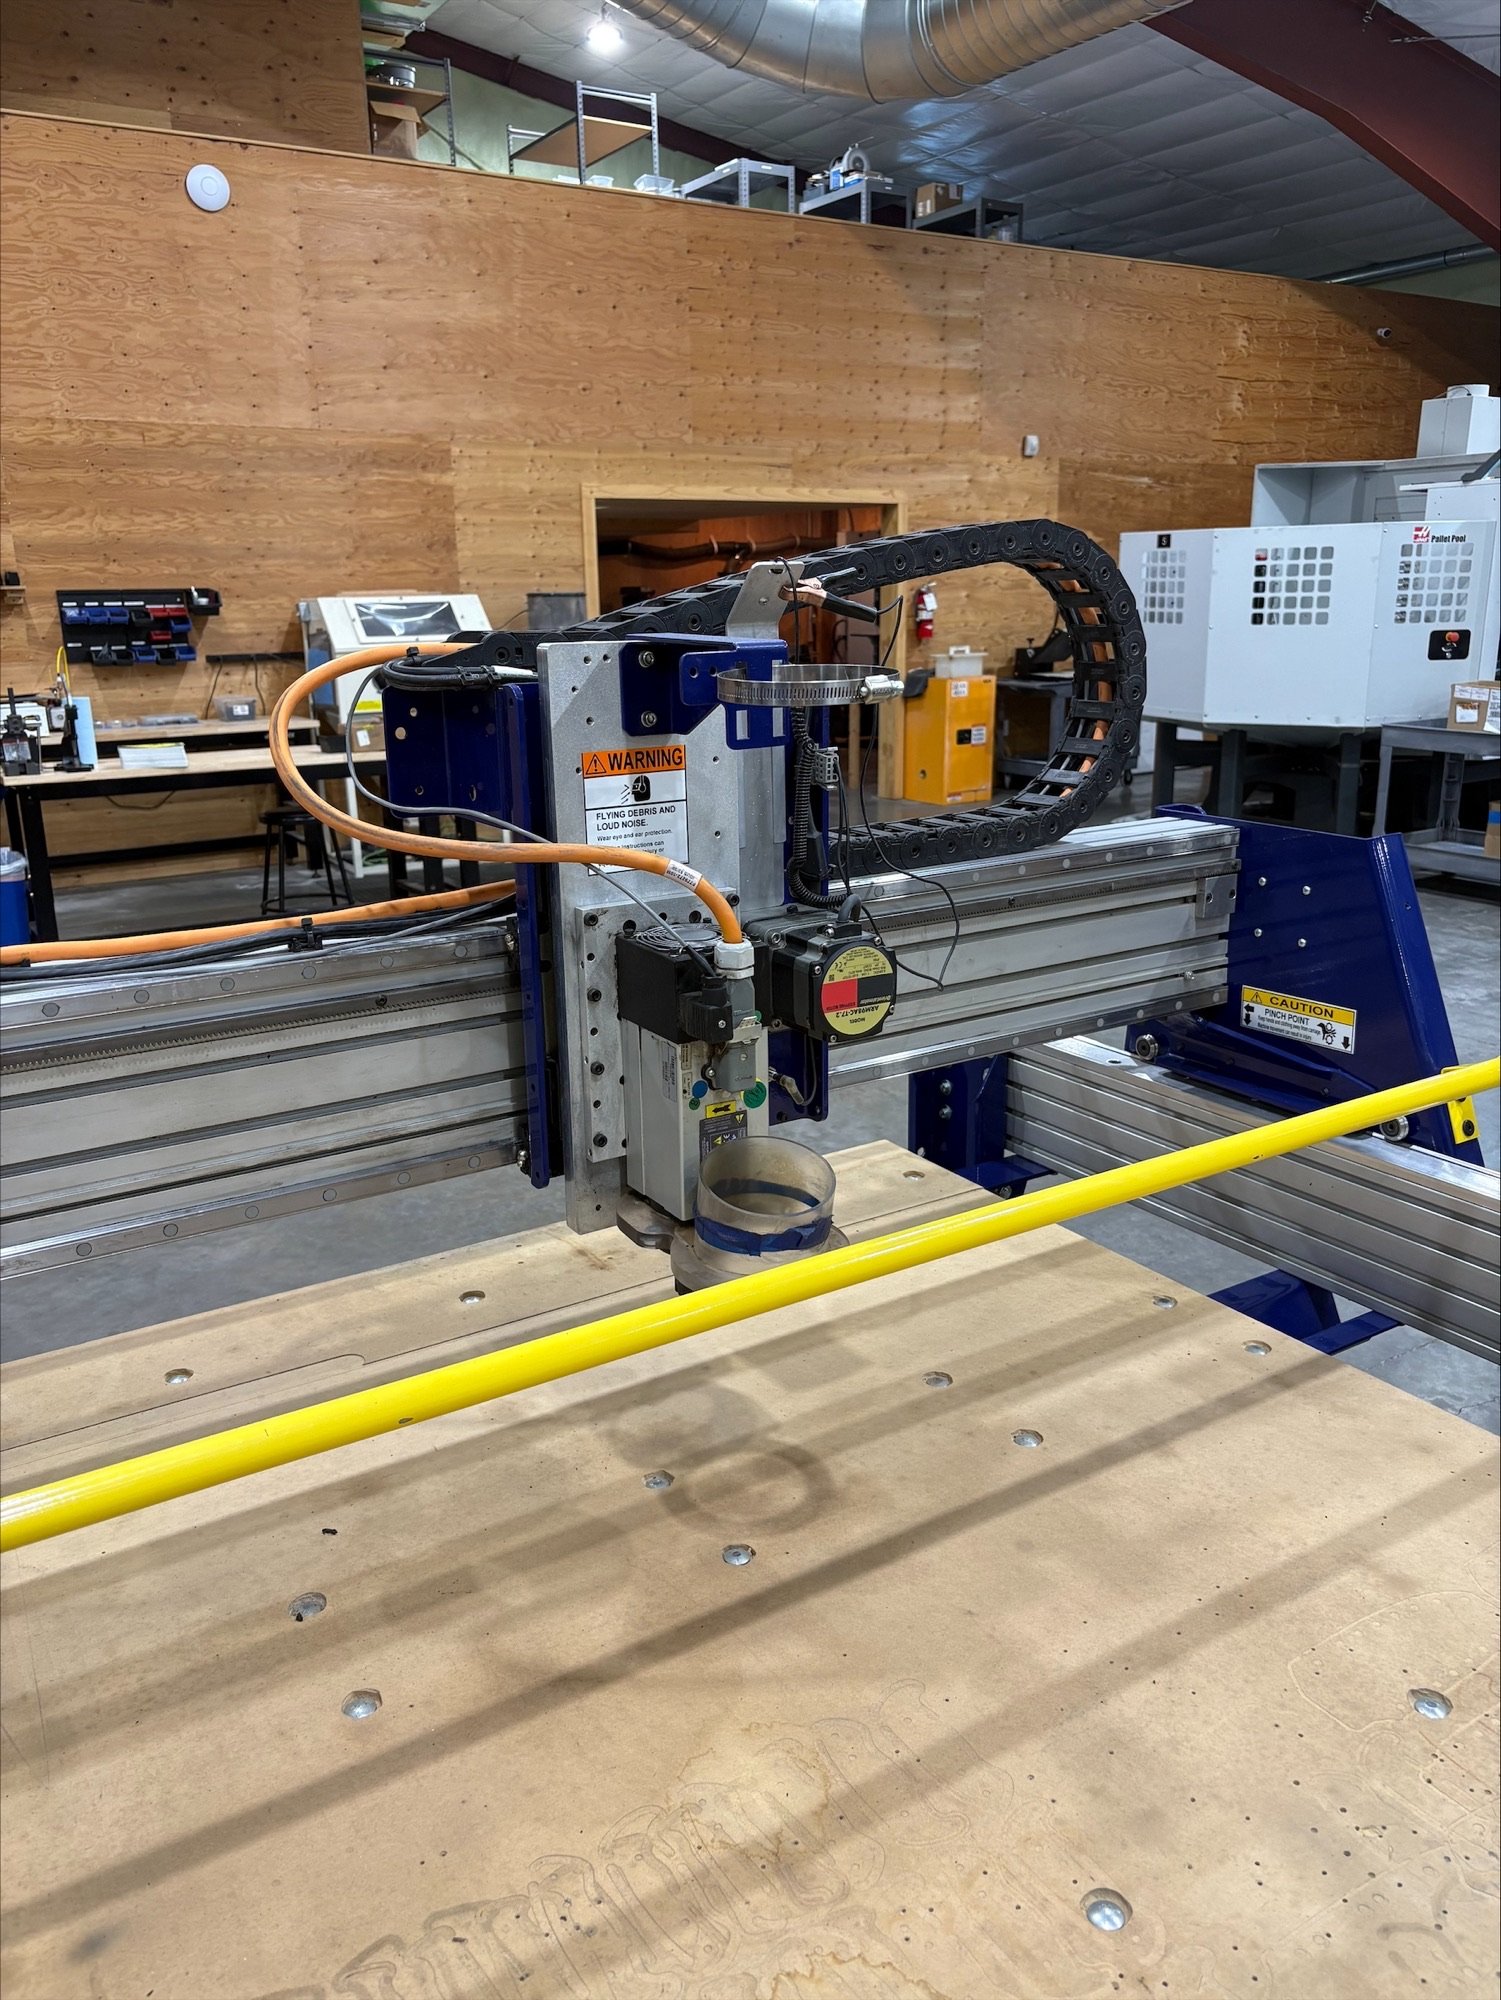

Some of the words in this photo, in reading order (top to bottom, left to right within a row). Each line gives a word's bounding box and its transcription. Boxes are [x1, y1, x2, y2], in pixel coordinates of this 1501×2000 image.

[1431, 535, 1450, 543] Pallet
[1451, 535, 1466, 543] Pool
[608, 748, 683, 771] WARNING
[596, 811, 626, 820] FLYING
[628, 807, 657, 817] DEBRIS
[659, 805, 676, 814] AND
[596, 821, 619, 831] LOUD
[622, 819, 648, 828] NOISE.
[1270, 996, 1334, 1018] CAUTION
[1264, 1008, 1286, 1020] PINCH
[1288, 1014, 1309, 1026] POINT
